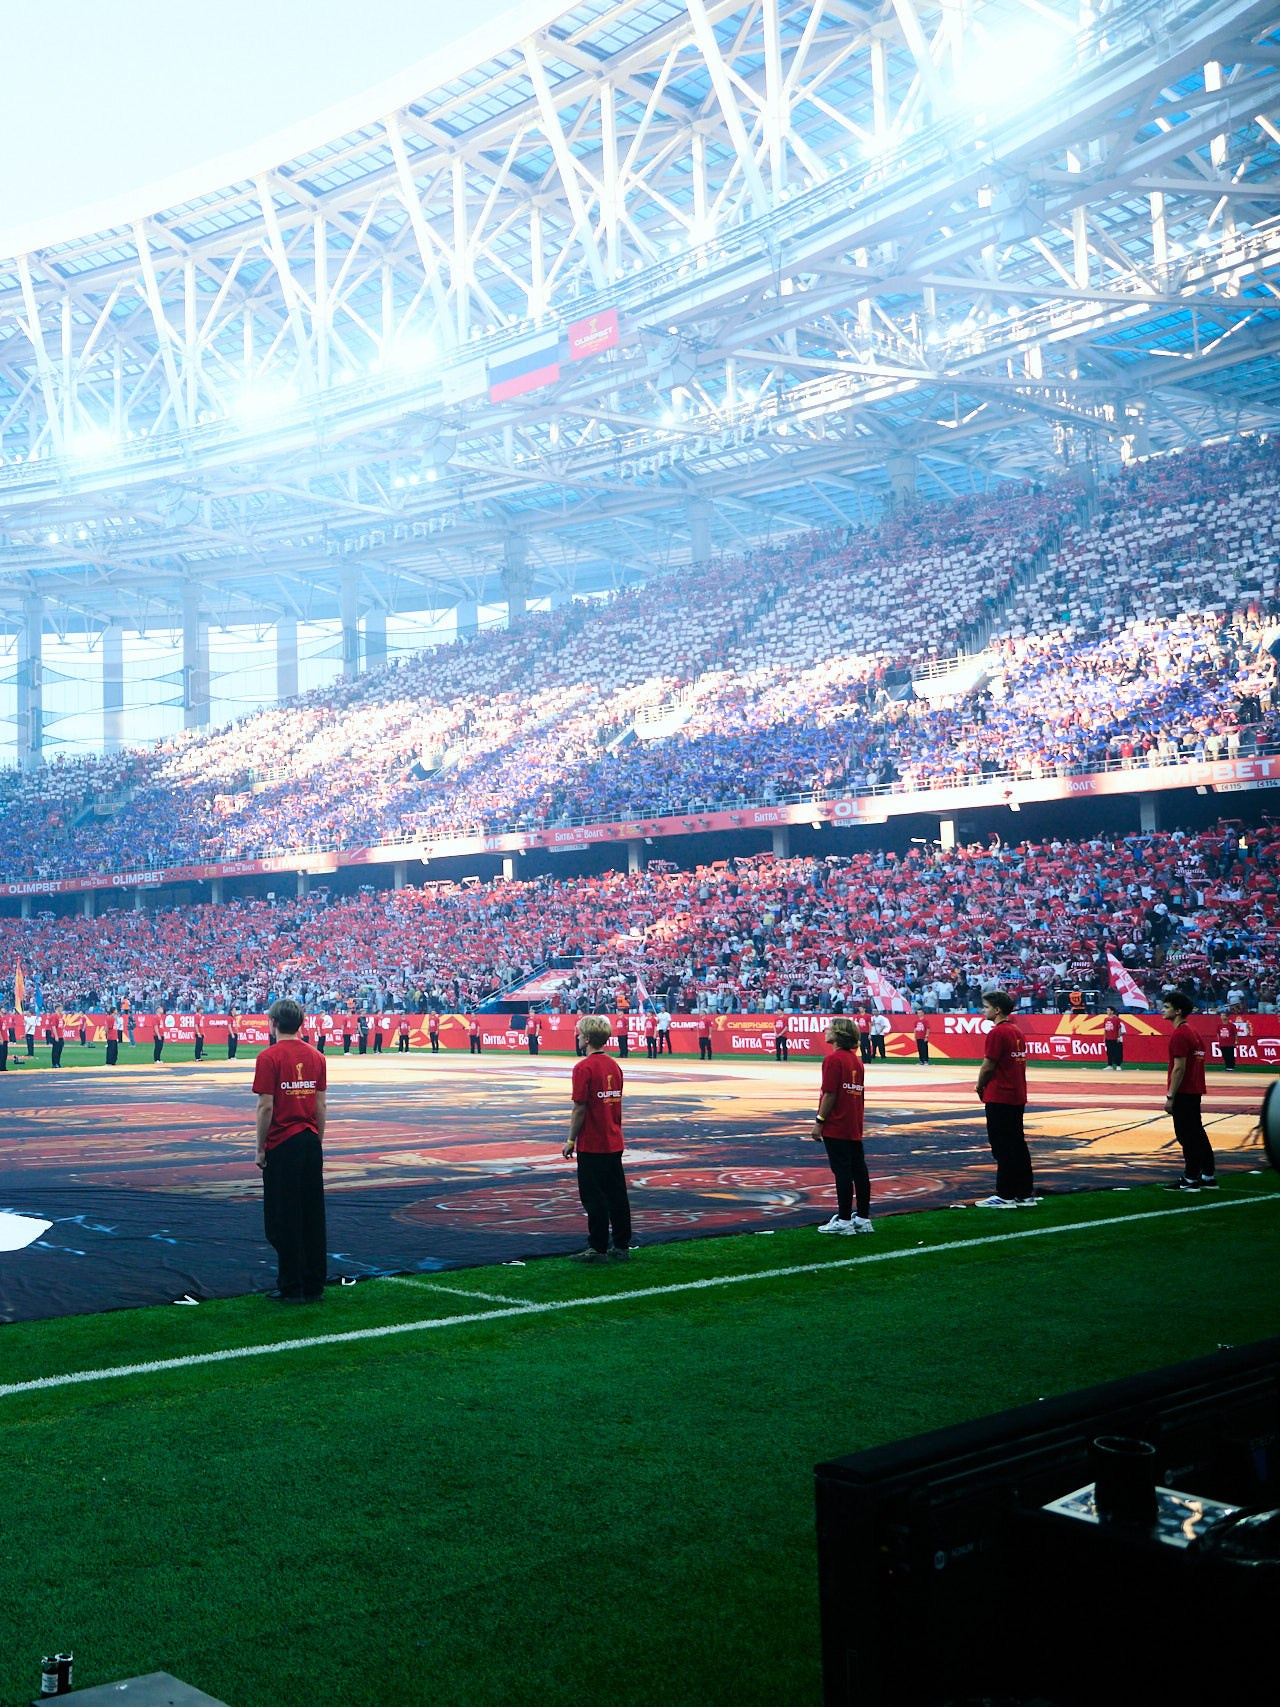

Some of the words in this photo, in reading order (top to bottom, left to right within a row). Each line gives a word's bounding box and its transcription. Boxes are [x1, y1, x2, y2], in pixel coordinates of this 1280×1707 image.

[112, 871, 165, 886] OLIMPBET
[8, 882, 62, 894] OLIMPBET
[788, 1016, 831, 1032] СПАР
[1072, 1040, 1106, 1055] Волг
